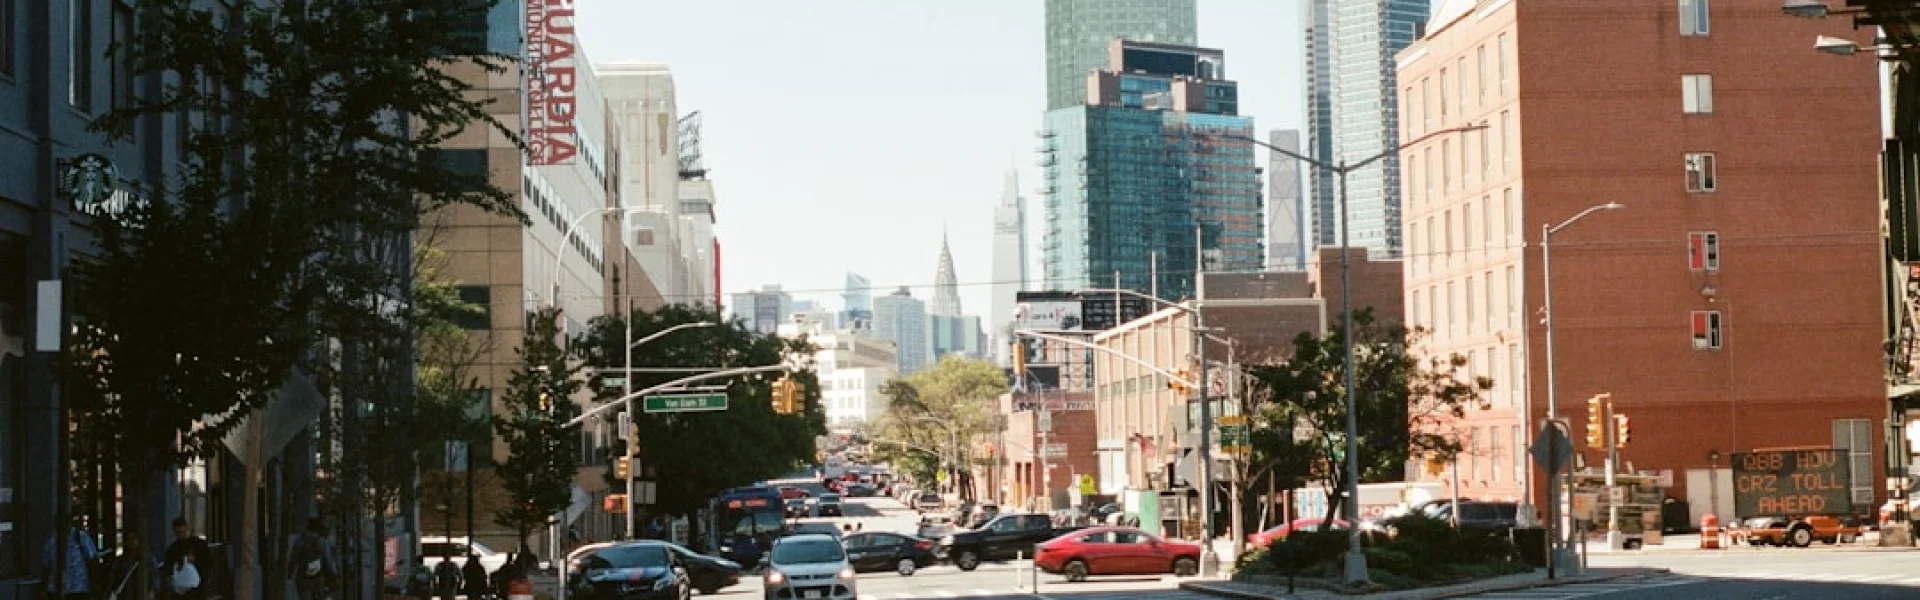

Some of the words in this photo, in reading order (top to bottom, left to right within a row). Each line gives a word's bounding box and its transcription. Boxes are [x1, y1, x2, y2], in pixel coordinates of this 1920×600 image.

[545, 0, 577, 165] UARDIA
[528, 77, 545, 165] COLLEGE
[1738, 474, 1778, 493] CRZ
[1791, 472, 1844, 491] TOLL
[1758, 495, 1825, 514] AHEAD
